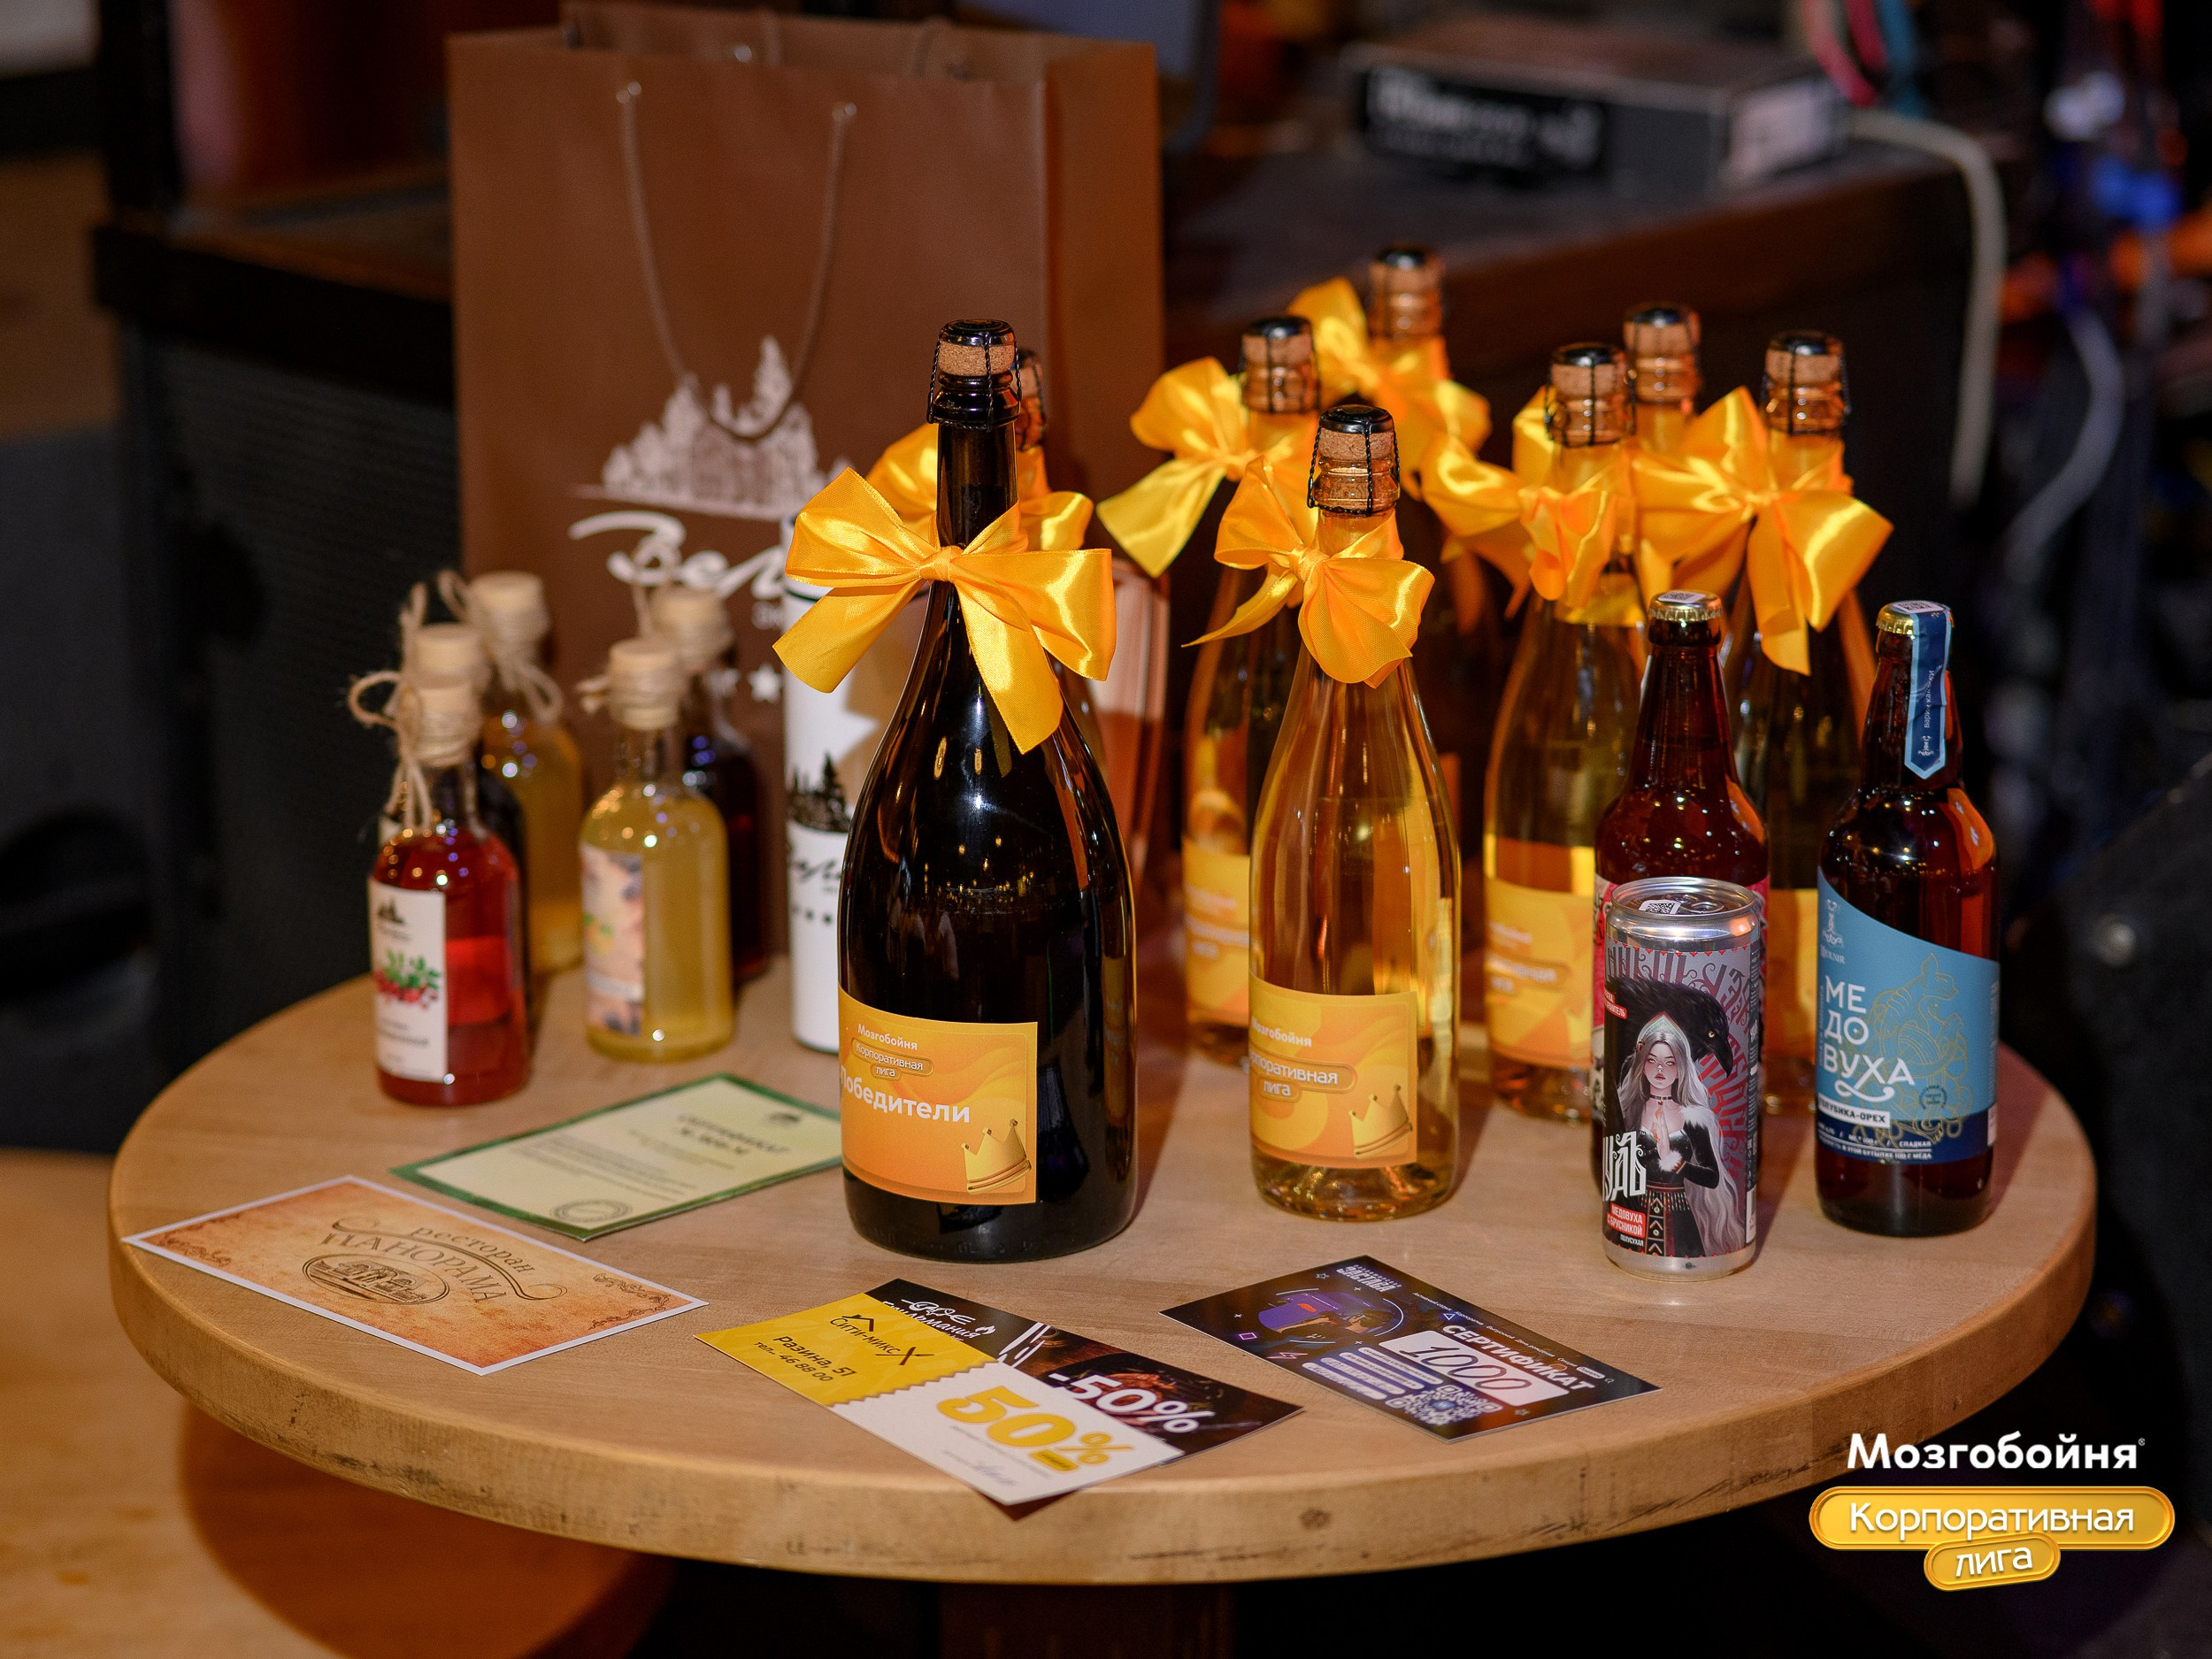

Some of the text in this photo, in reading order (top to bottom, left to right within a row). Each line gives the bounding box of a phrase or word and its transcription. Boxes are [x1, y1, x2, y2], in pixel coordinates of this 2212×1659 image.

[1824, 975, 1866, 1014] МЕ
[857, 1023, 918, 1050] Мозгобойня
[1824, 1010, 1869, 1045] ДО
[856, 1042, 923, 1071] Корпоративная
[875, 1065, 895, 1078] лига
[1824, 1049, 1915, 1102] ВУХА
[841, 1064, 970, 1124] Победители
[1263, 1081, 1291, 1097] лига
[1610, 1217, 1643, 1236] БРУСНИКОЙ
[1611, 1205, 1643, 1225] МЕДОВУХА
[319, 1232, 507, 1302] ПАНОРАМА
[410, 1226, 536, 1275] ресторан
[773, 1336, 856, 1377] Разина, 51
[779, 1354, 795, 1364] 46
[795, 1361, 812, 1373] 88
[813, 1371, 833, 1382] 00
[1399, 1346, 1532, 1390] 1000
[1442, 1325, 1595, 1390] СЕРТИФИКАТ
[1048, 1373, 1216, 1433] -50%
[937, 1386, 1133, 1465] 50%
